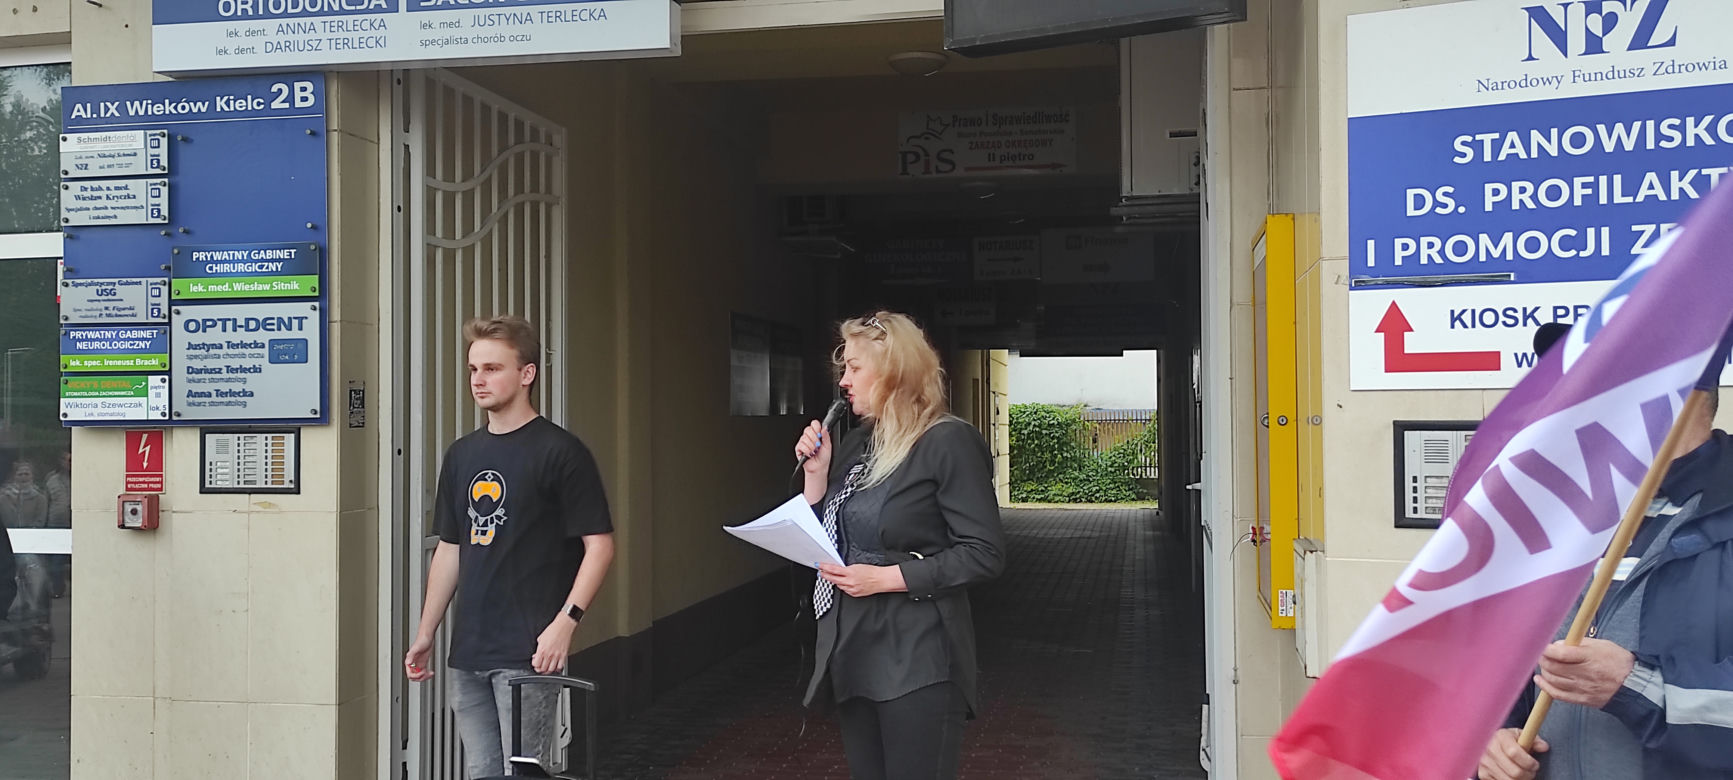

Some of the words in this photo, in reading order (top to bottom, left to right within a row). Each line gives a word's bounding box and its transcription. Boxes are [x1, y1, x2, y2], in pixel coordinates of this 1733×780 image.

[420, 21, 436, 30] lek.
[439, 19, 463, 29] med.
[471, 12, 533, 28] JUSTYNA
[538, 8, 608, 24] TERLECKA
[226, 28, 242, 38] lek.
[245, 27, 268, 37] dent.
[276, 22, 317, 36] ANNA
[321, 18, 387, 33] TERLECKA
[1521, 0, 1678, 62] NFZ
[216, 46, 231, 56] lek.
[234, 46, 257, 55] dent.
[264, 39, 322, 54] DARIUSZ
[327, 36, 387, 51] TERLECKI
[420, 36, 468, 48] specjalista
[472, 33, 506, 44] chorób
[509, 34, 532, 42] oczu
[1476, 73, 1565, 94] Narodowy
[1572, 64, 1646, 84] Fundusz
[1652, 56, 1728, 76] Zdrowia
[126, 98, 209, 116] Wieków
[216, 95, 265, 112] Kielc
[270, 81, 315, 110] 2B
[952, 114, 983, 128] Prawo
[992, 108, 1071, 129] Sprawiedliwość
[968, 140, 1002, 152] ZARZĄD
[1004, 138, 1054, 150] OKRĘGOWY
[898, 148, 957, 176] PiS
[999, 152, 1035, 164] piętro
[1406, 186, 1467, 218] DS.
[1484, 167, 1733, 212] PROFILAKT
[1366, 239, 1376, 268] I
[1394, 226, 1611, 267] PROMOCJI
[192, 251, 249, 261] PRYWATNY
[251, 249, 296, 260] GABINET
[206, 262, 284, 274] CHIRURGICZNY
[96, 288, 117, 297] USG
[190, 284, 207, 292] lek.
[208, 282, 232, 292] med.
[232, 282, 271, 291] Wiesław
[272, 281, 300, 290] Sitnik
[1449, 306, 1542, 330] KIOSK
[184, 316, 308, 334] OPTI-DENT
[70, 330, 117, 340] PRYWATNY
[119, 330, 158, 338] GABINET
[76, 340, 152, 350] NEUROLOGICZNY
[186, 342, 223, 352] Justyna
[225, 340, 265, 350] Terlecka
[84, 360, 102, 368] spec.
[104, 358, 134, 366] Ireneusz
[136, 358, 159, 366] Bracki
[186, 352, 221, 362] specjalista
[222, 352, 247, 360] chorób
[186, 366, 223, 375] Dariusz
[225, 364, 262, 374] Terlecki
[186, 376, 207, 384] lekarz
[208, 376, 247, 386] stomatolog
[186, 389, 212, 398] Anna
[214, 388, 254, 398] Terlecka
[64, 401, 98, 409] Wiktoria
[100, 400, 144, 408] Szewczak
[186, 400, 207, 408] lekarz
[208, 400, 247, 408] stomatolog
